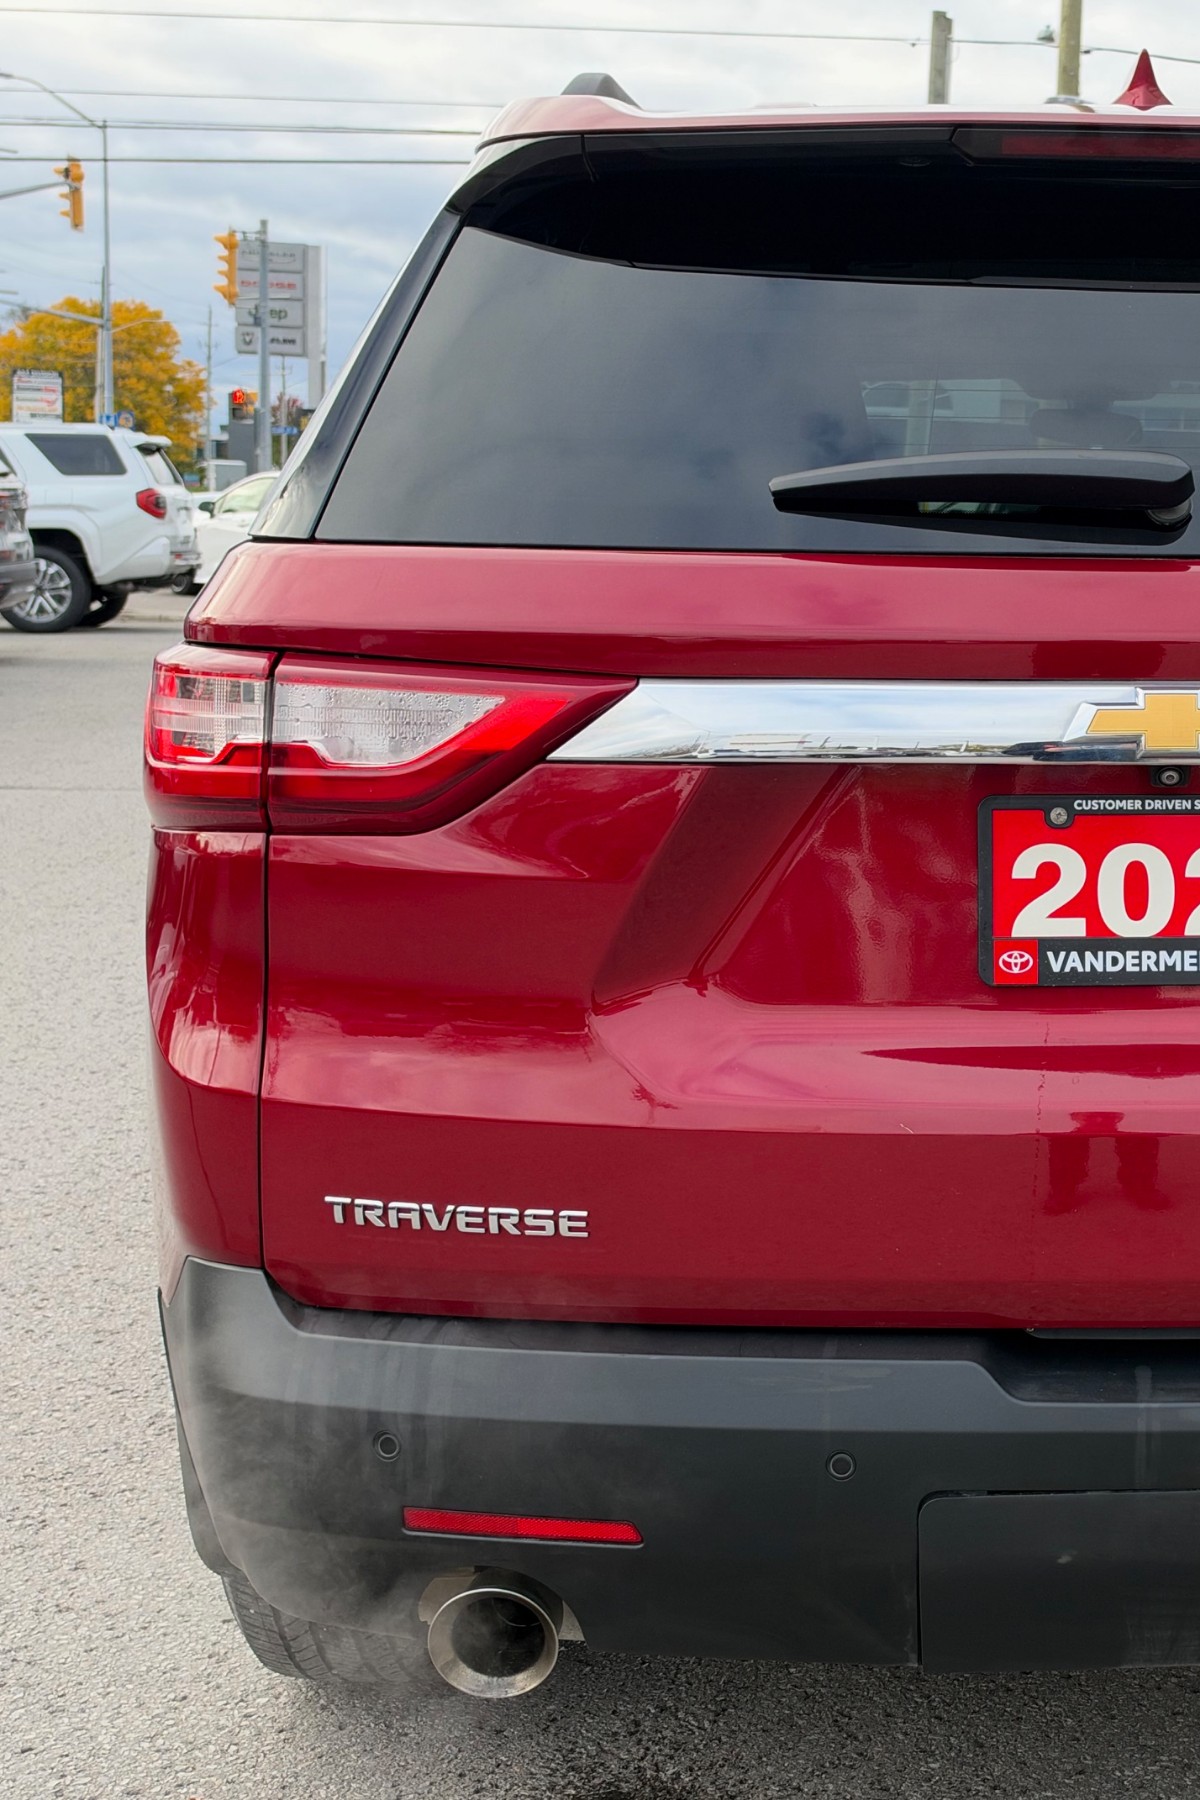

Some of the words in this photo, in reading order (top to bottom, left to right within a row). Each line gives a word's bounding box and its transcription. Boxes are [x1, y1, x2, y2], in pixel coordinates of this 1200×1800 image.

[248, 304, 288, 321] Jep
[1073, 799, 1143, 811] CUSTOMER
[1145, 799, 1192, 811] DRIVEN
[323, 1195, 590, 1239] TRAVERSE
